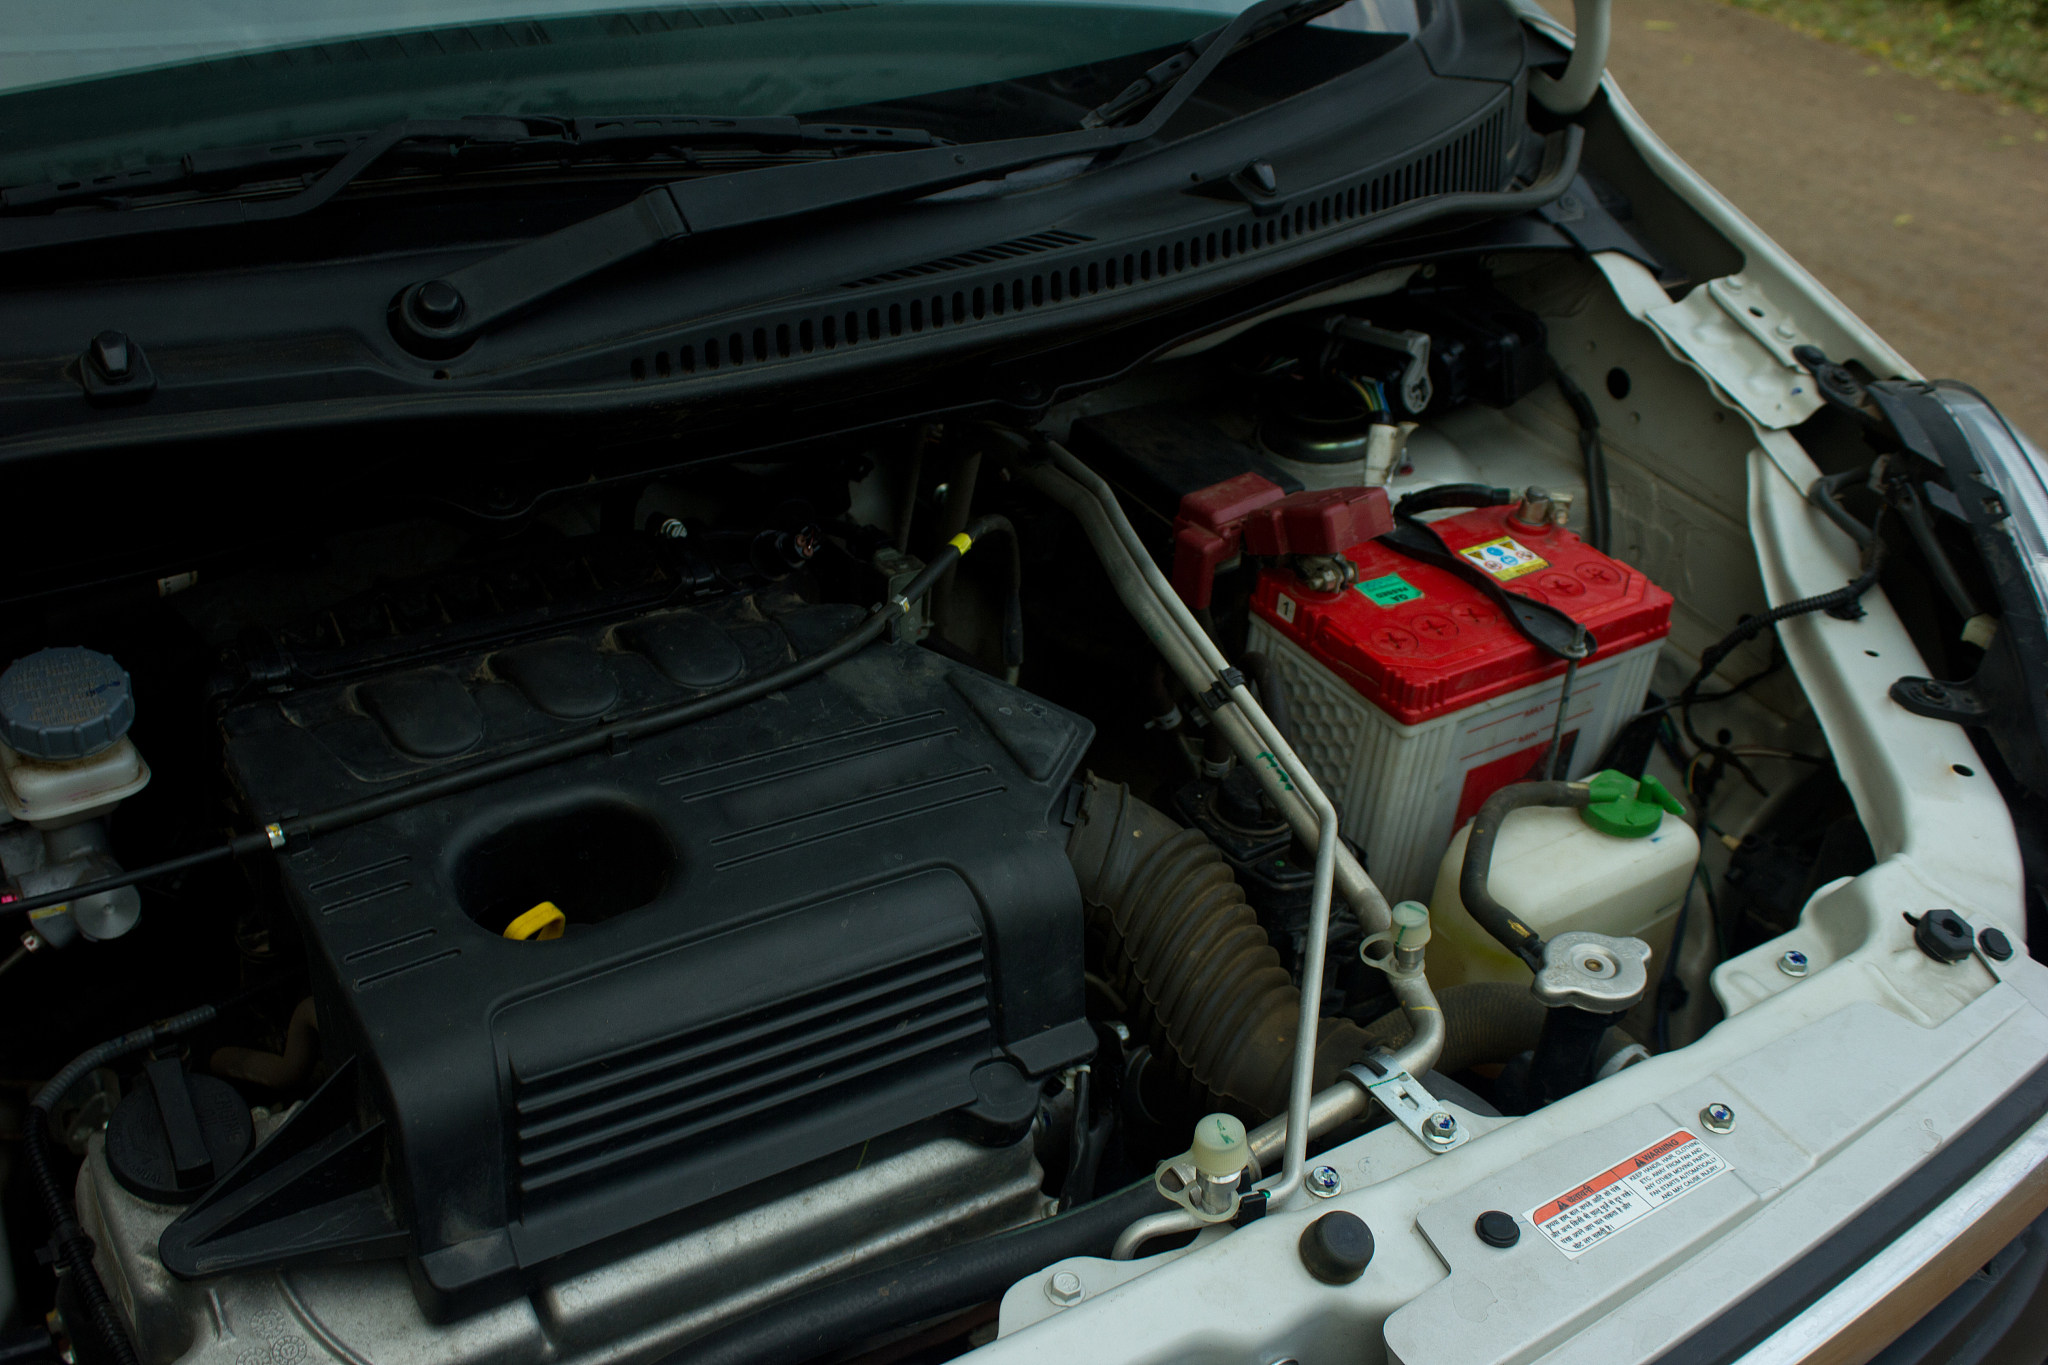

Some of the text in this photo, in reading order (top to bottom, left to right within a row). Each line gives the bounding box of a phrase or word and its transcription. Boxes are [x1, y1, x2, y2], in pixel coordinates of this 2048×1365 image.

[1283, 601, 1289, 615] 1
[1524, 704, 1546, 717] MAX
[1518, 730, 1539, 743] MIN
[214, 1092, 243, 1143] ENGINE
[1641, 1139, 1679, 1162] WARNING
[1651, 1167, 1666, 1178] AWAY
[1665, 1158, 1681, 1170] FROM
[1680, 1152, 1691, 1161] FAN
[1690, 1147, 1702, 1156] AND
[1629, 1171, 1642, 1181] KEEP
[1644, 1181, 1656, 1191] ANY
[1655, 1172, 1673, 1185] OTHER
[1672, 1161, 1693, 1175] MOVING
[1649, 1156, 1717, 1197] FAN STARTS AUTOMATICALLY
[1661, 1191, 1673, 1200] AND
[1672, 1184, 1684, 1194] MAY
[1683, 1174, 1701, 1187] CAUSE
[1566, 1184, 1594, 1204] चेतावनी
